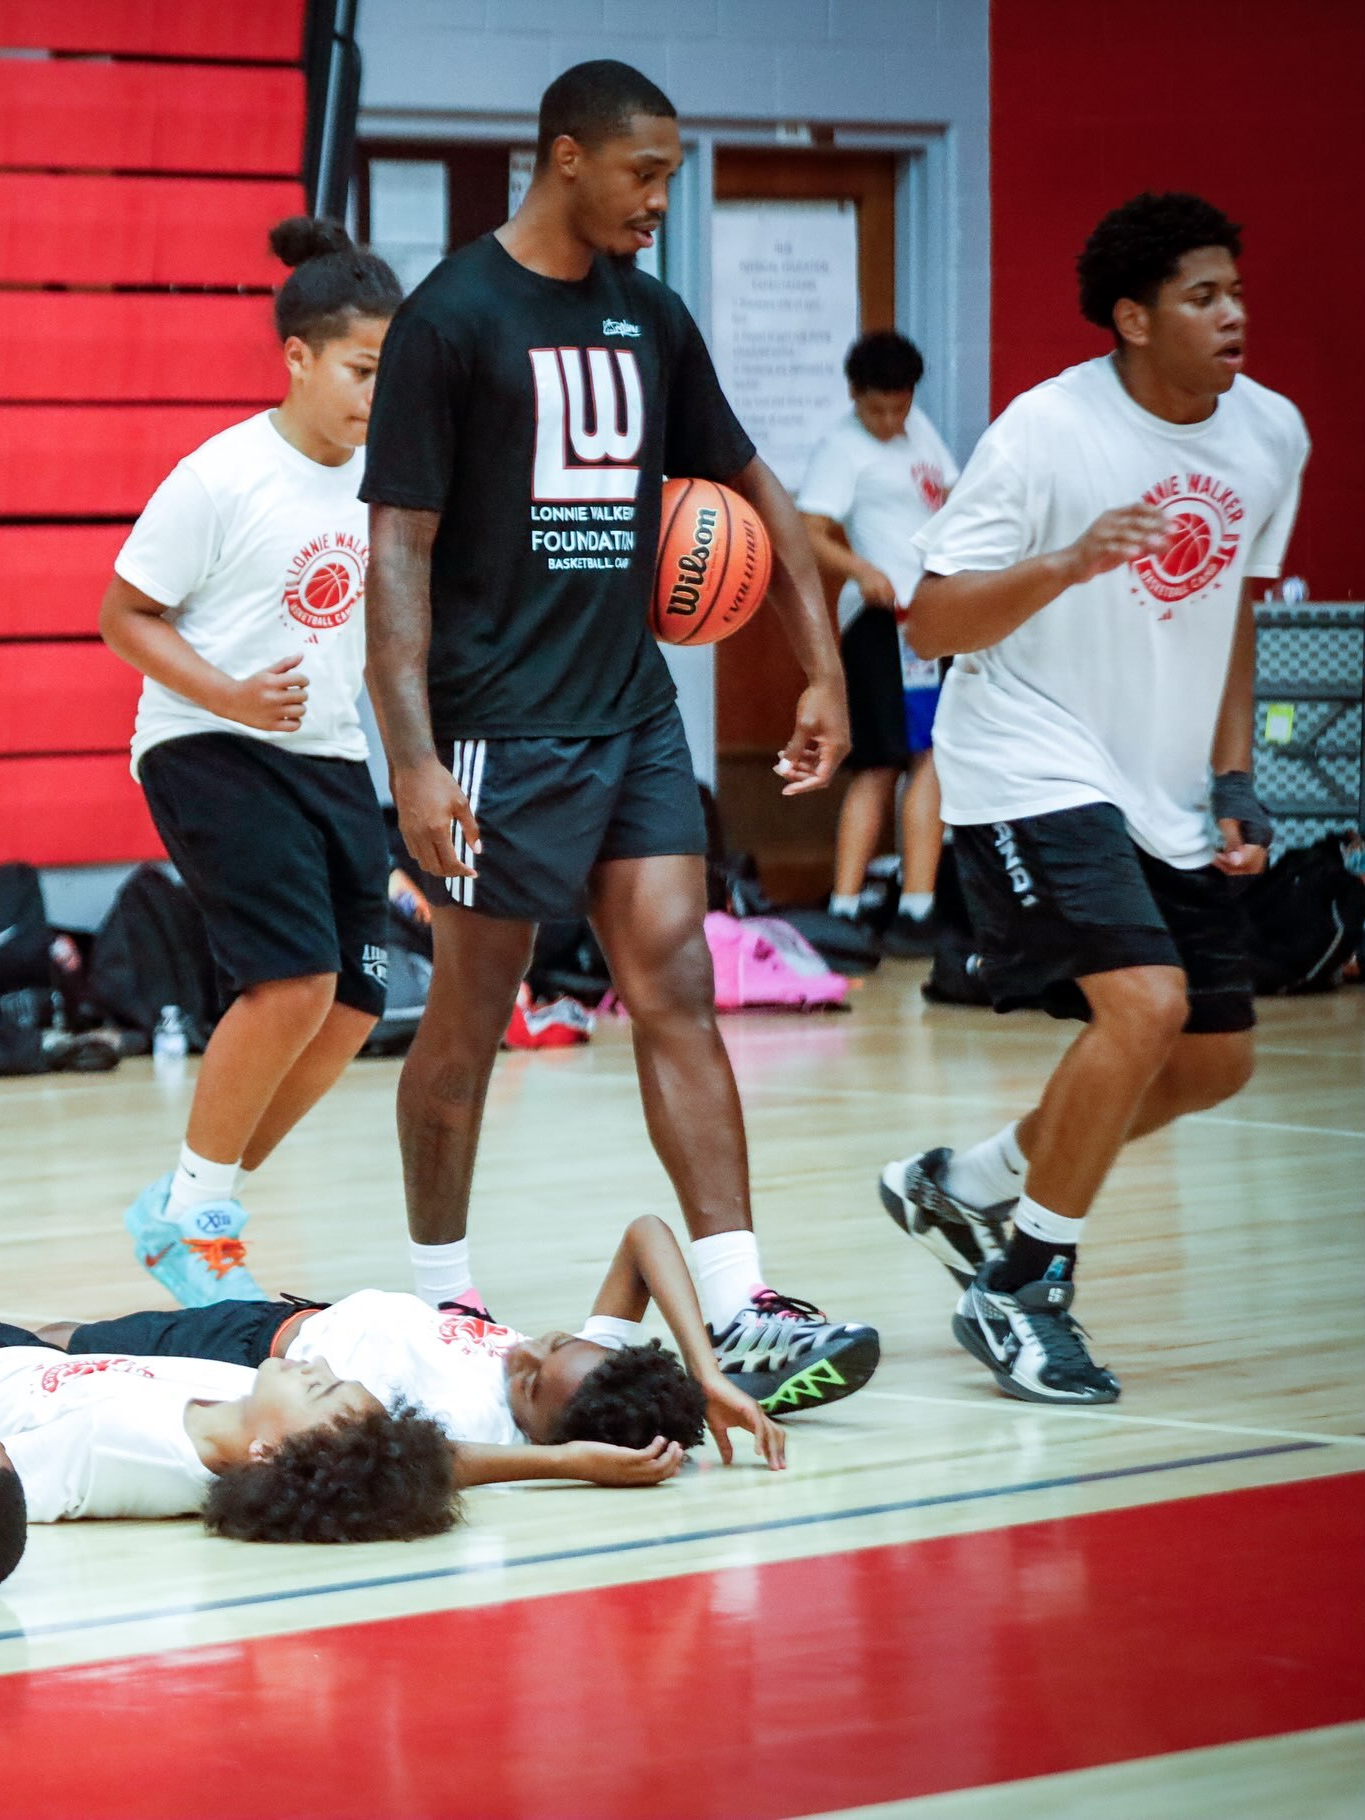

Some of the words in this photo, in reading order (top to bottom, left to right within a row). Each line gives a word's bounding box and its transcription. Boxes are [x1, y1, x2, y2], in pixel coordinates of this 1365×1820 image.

[530, 506, 590, 521] LONNIE
[1141, 475, 1180, 506] NNIE
[1186, 473, 1244, 524] WALKER
[286, 533, 331, 577] LONNIE
[335, 531, 369, 568] WALK
[547, 557, 614, 570] BASKETBALL
[666, 507, 718, 617] Wilson
